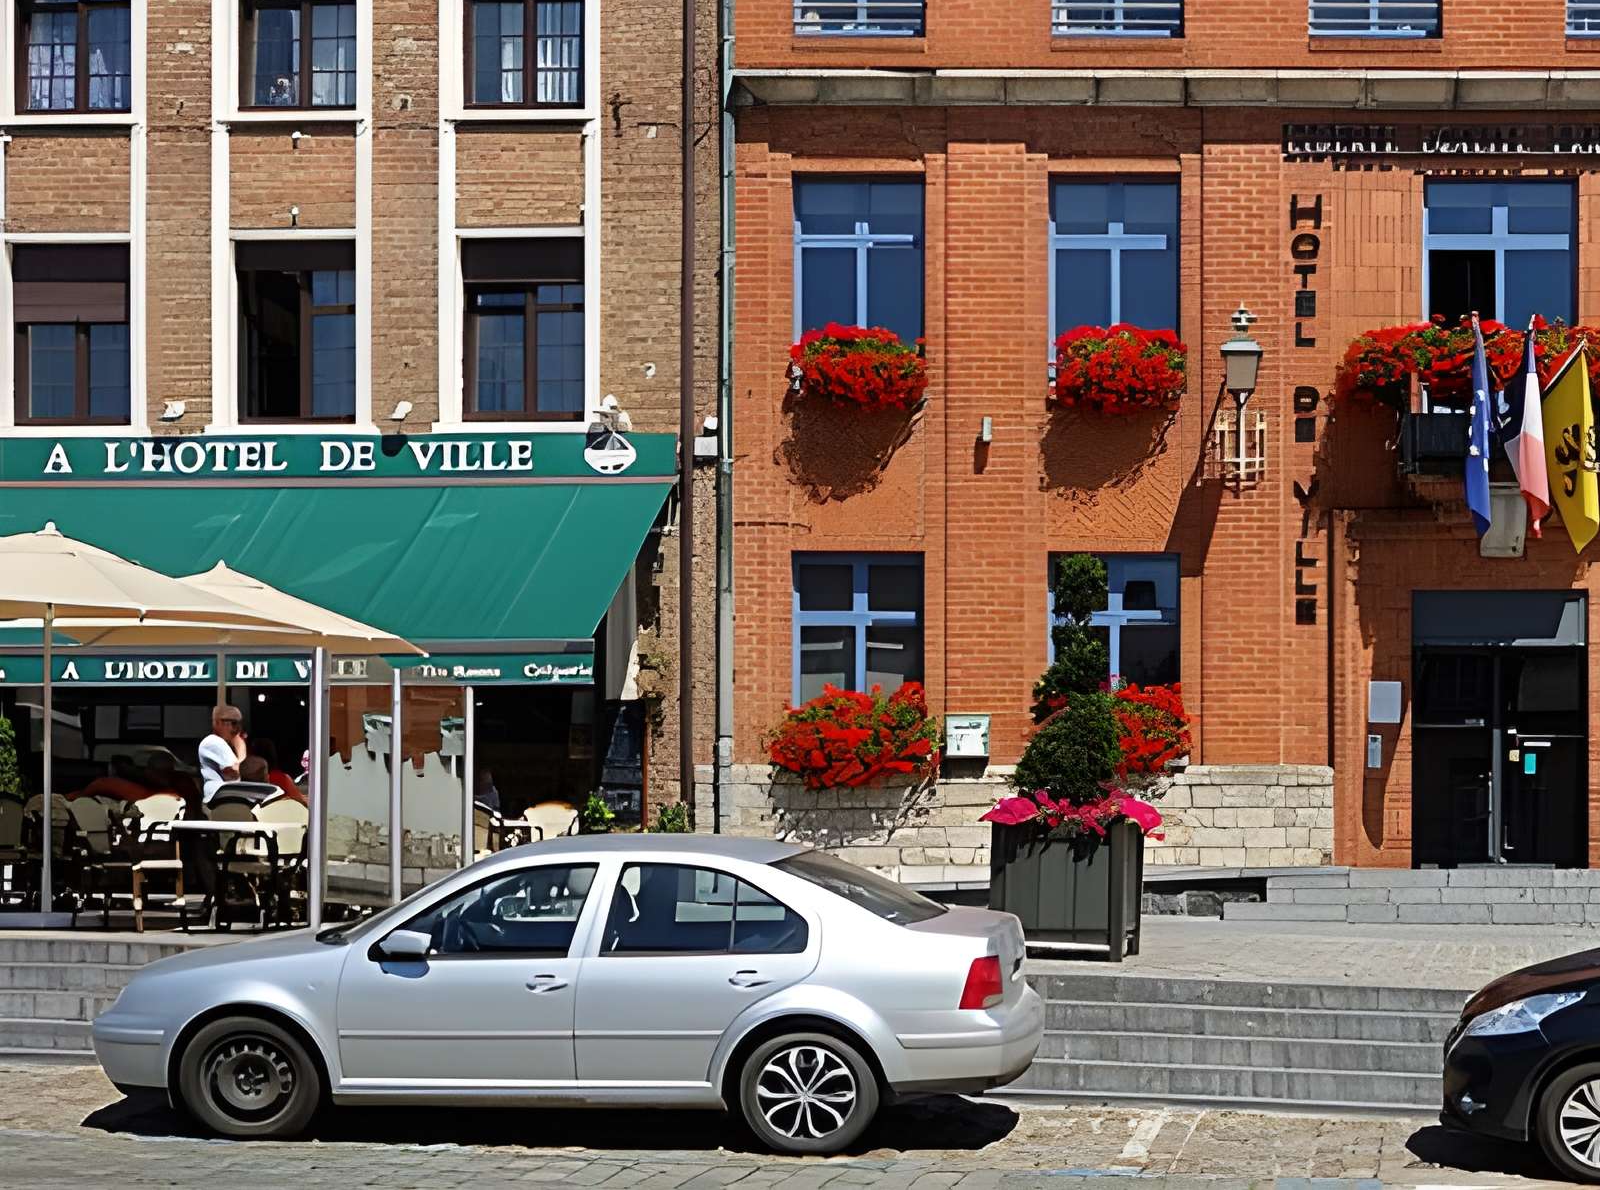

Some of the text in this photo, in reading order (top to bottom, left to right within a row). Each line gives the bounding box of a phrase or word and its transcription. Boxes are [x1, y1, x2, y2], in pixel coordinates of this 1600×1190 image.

[43, 441, 533, 473] A L'HOTEL DE VILLE
